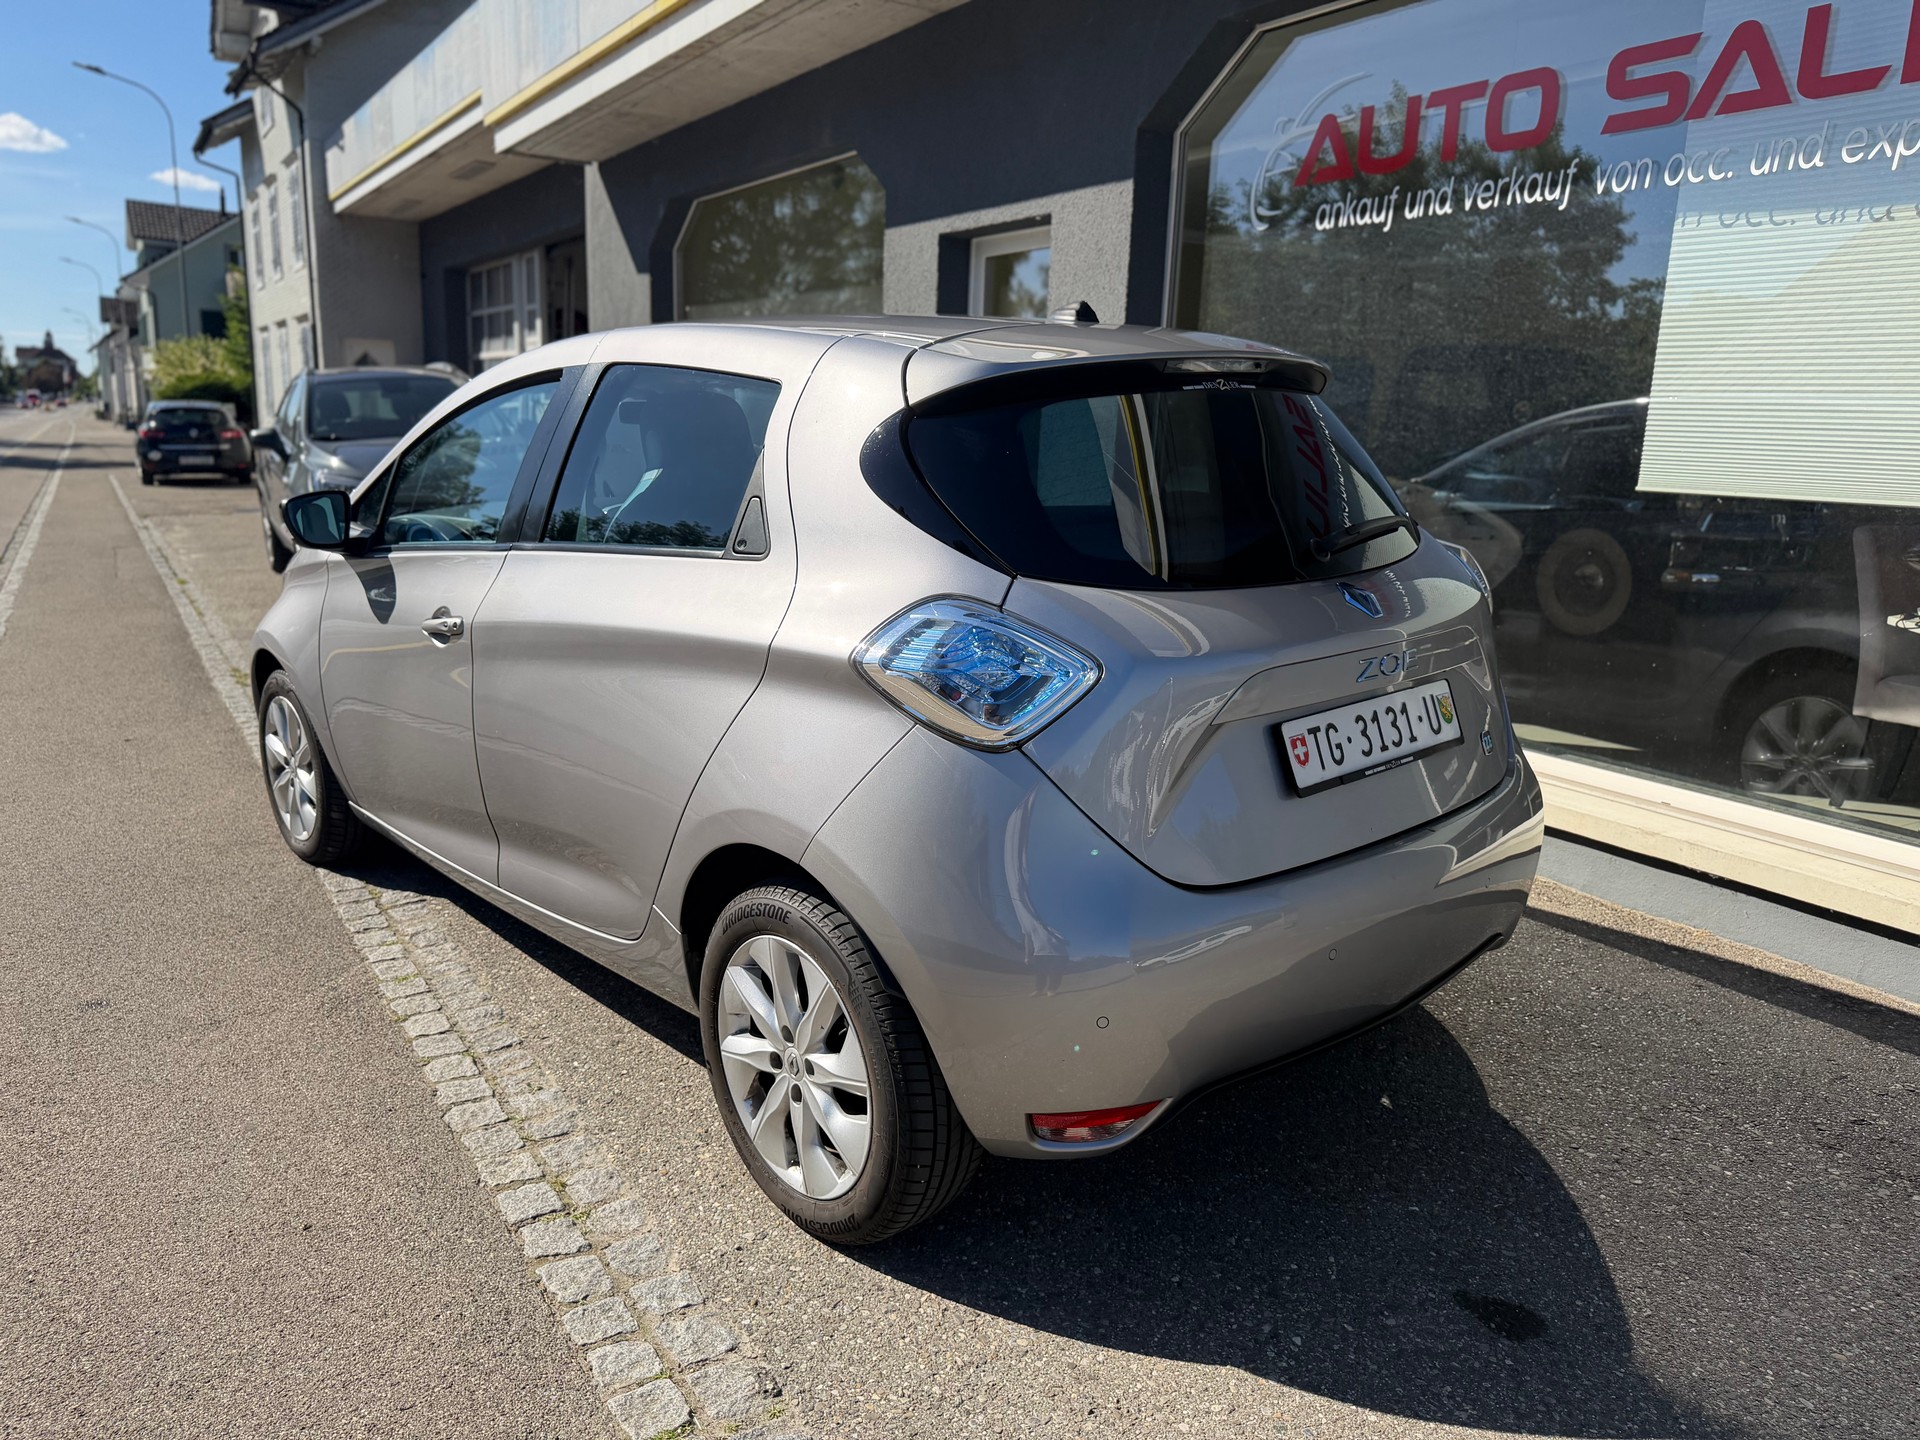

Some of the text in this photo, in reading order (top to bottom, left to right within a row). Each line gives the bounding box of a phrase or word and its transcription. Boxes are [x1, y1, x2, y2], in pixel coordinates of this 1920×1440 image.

[1295, 66, 1560, 187] AUTO
[1315, 186, 1399, 232] ankauf
[1404, 176, 1454, 220] und
[1464, 158, 1580, 211] verkauf
[1596, 157, 1652, 195] von
[1663, 147, 1734, 187] occ.
[1750, 120, 1831, 176] und
[1356, 648, 1419, 683] ZOE
[722, 902, 792, 936] BRIDGESTONE
